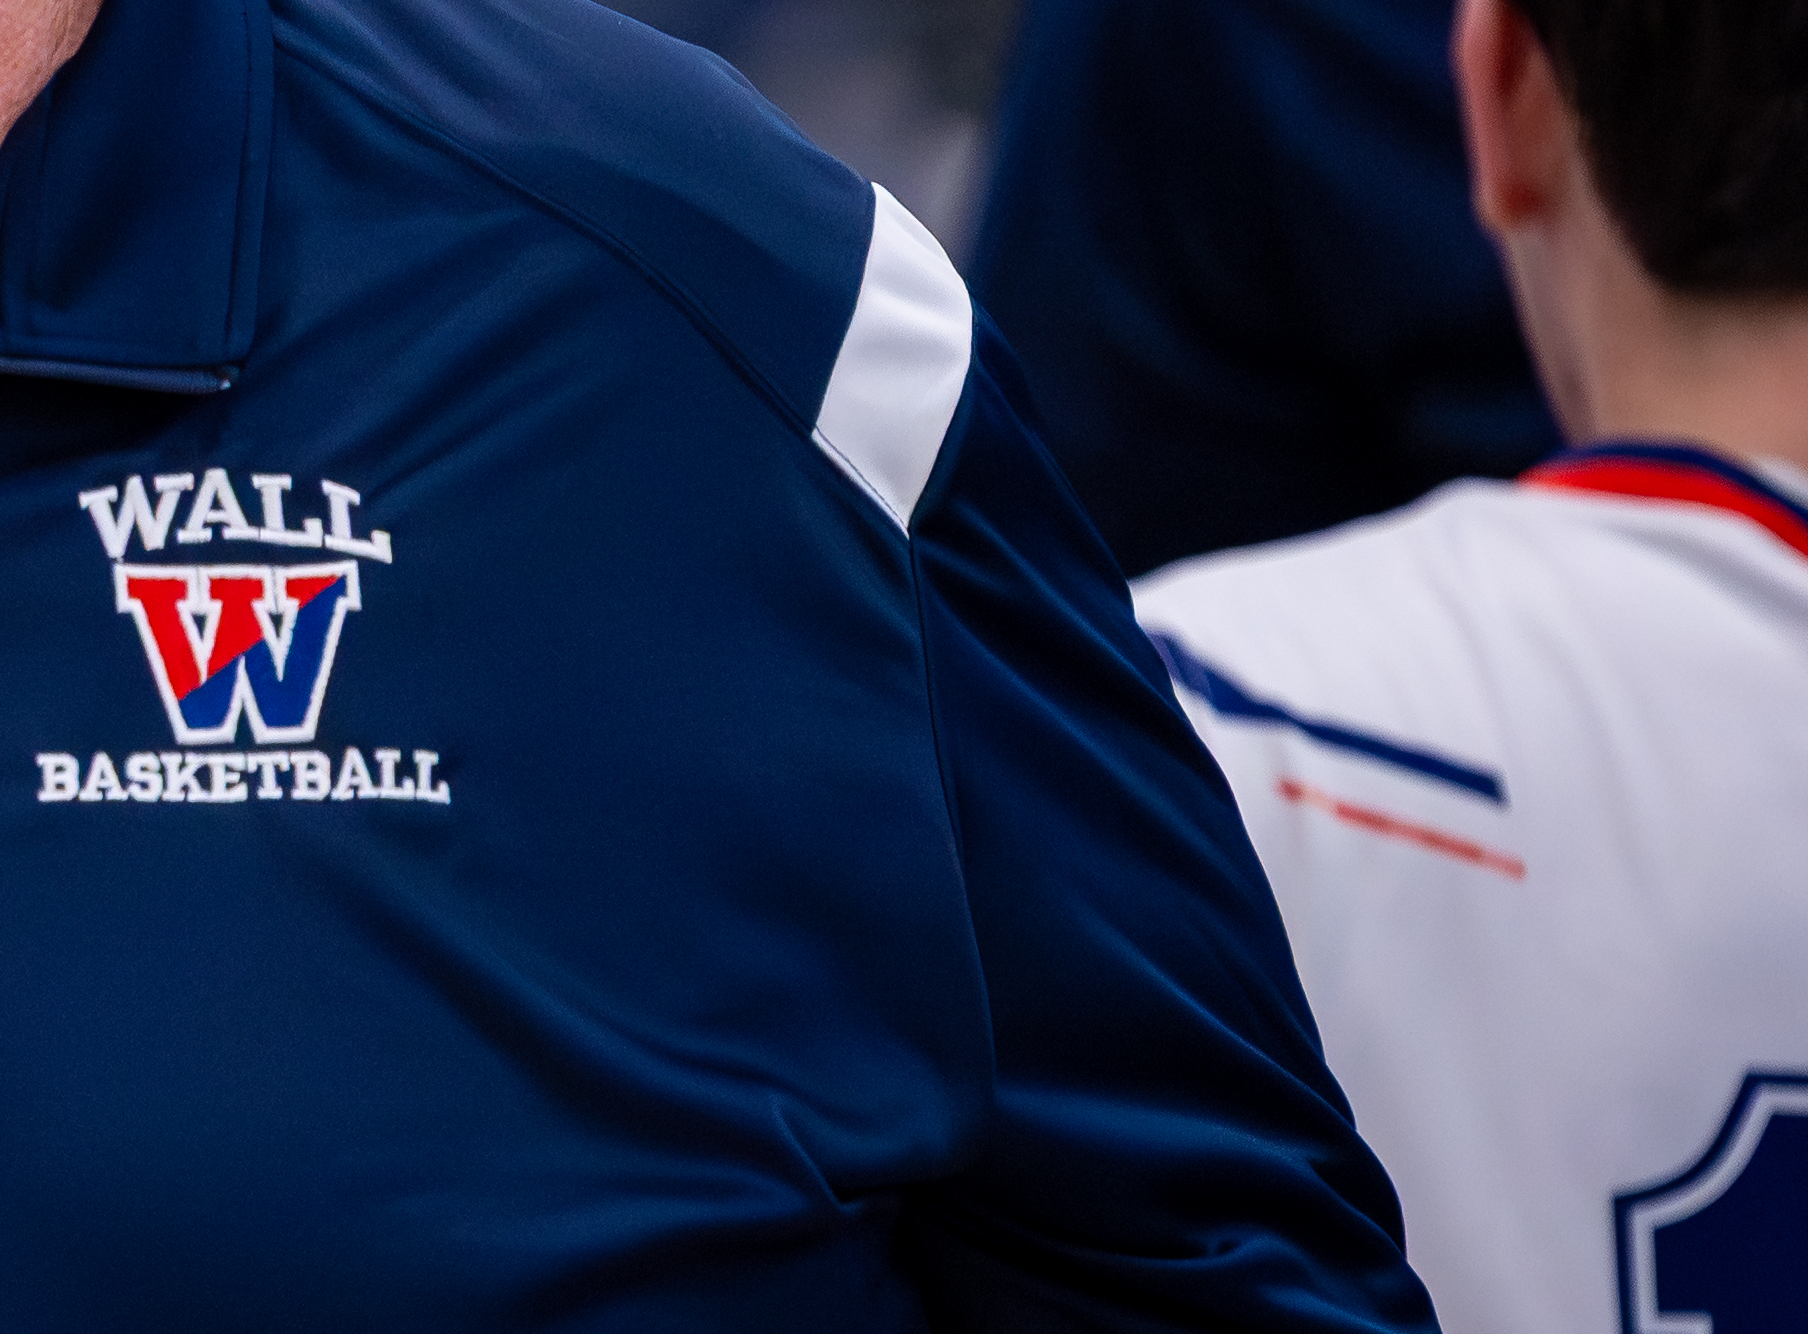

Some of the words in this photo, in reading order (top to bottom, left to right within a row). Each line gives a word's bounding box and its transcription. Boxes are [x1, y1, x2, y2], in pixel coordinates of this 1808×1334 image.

[78, 467, 393, 564] WALL
[114, 560, 362, 744] W
[36, 747, 452, 804] BASKETBALL
